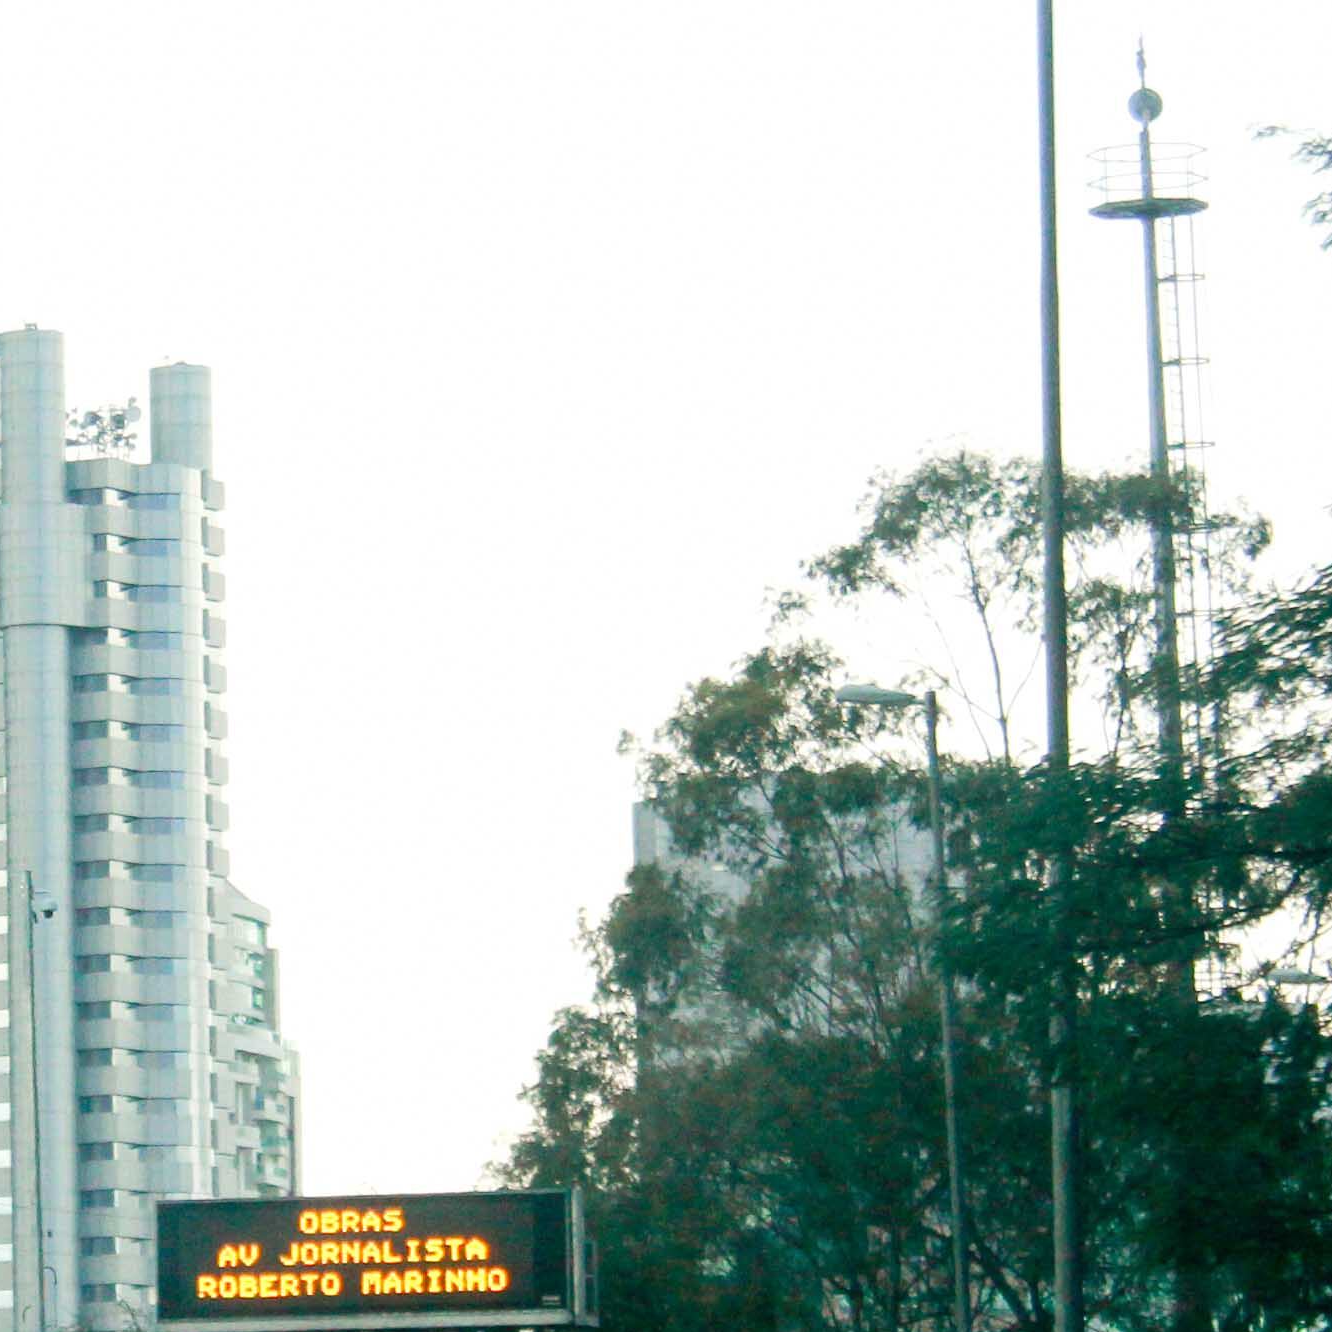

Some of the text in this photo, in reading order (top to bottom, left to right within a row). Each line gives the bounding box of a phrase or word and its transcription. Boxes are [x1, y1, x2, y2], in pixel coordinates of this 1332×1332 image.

[299, 1209, 405, 1234] OBRAS
[217, 1238, 490, 1268] AV JORNALISTA
[196, 1268, 509, 1299] ROBERTO MARINHO
